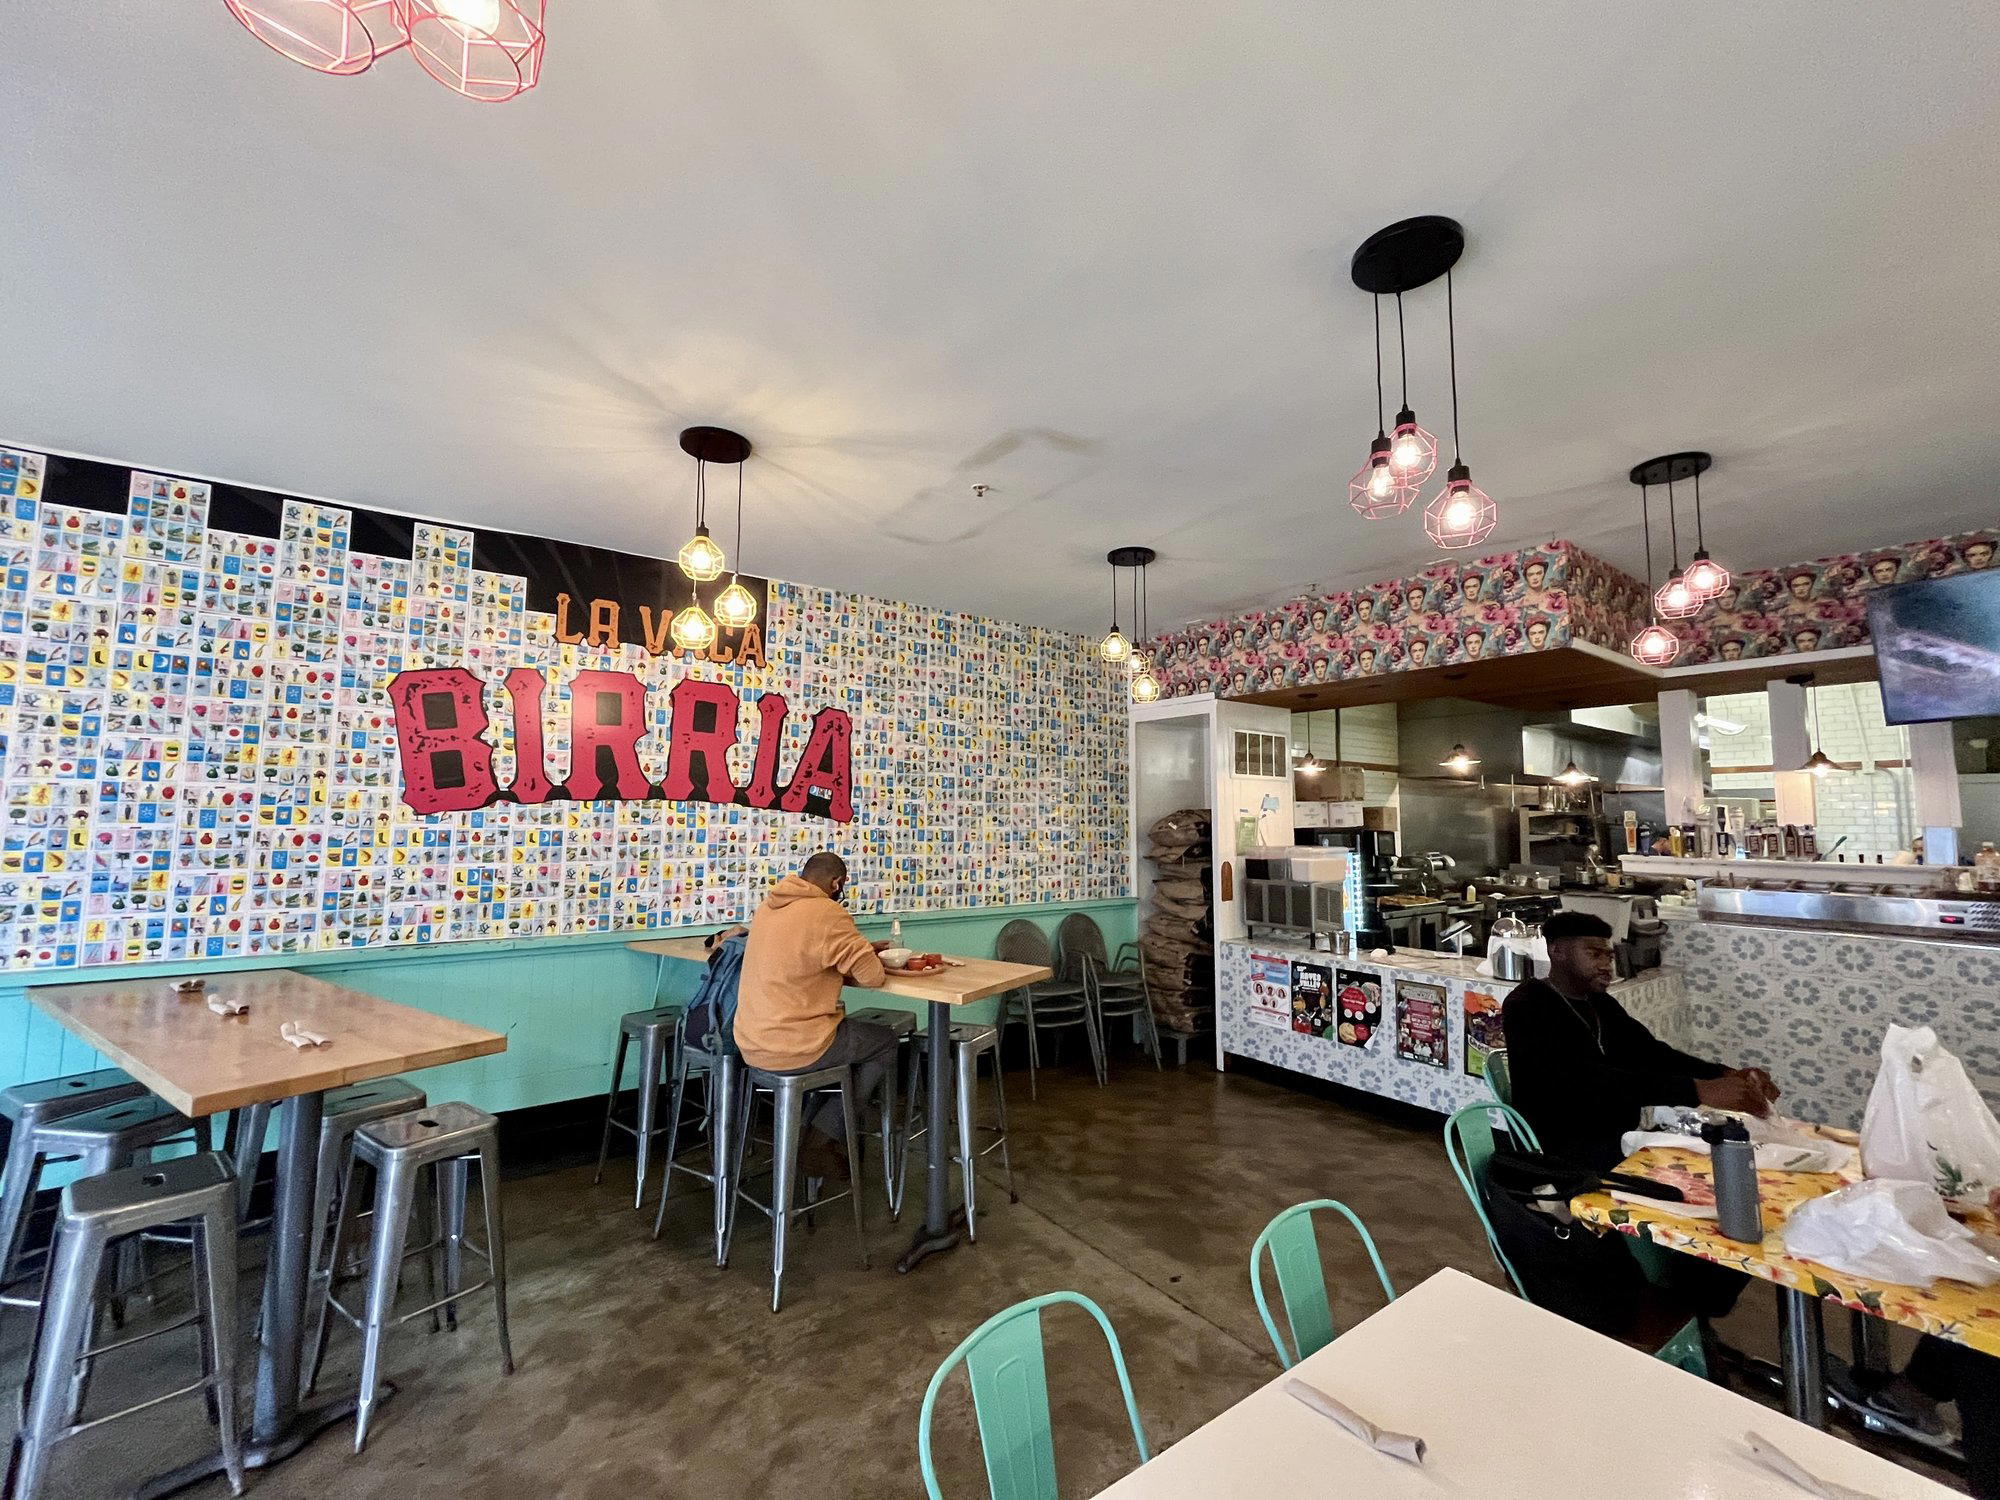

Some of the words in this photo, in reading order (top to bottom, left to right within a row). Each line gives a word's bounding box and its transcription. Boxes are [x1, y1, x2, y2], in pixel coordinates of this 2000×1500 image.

[552, 592, 620, 649] LA
[638, 605, 766, 668] VCA
[387, 667, 855, 823] BIRRIA
